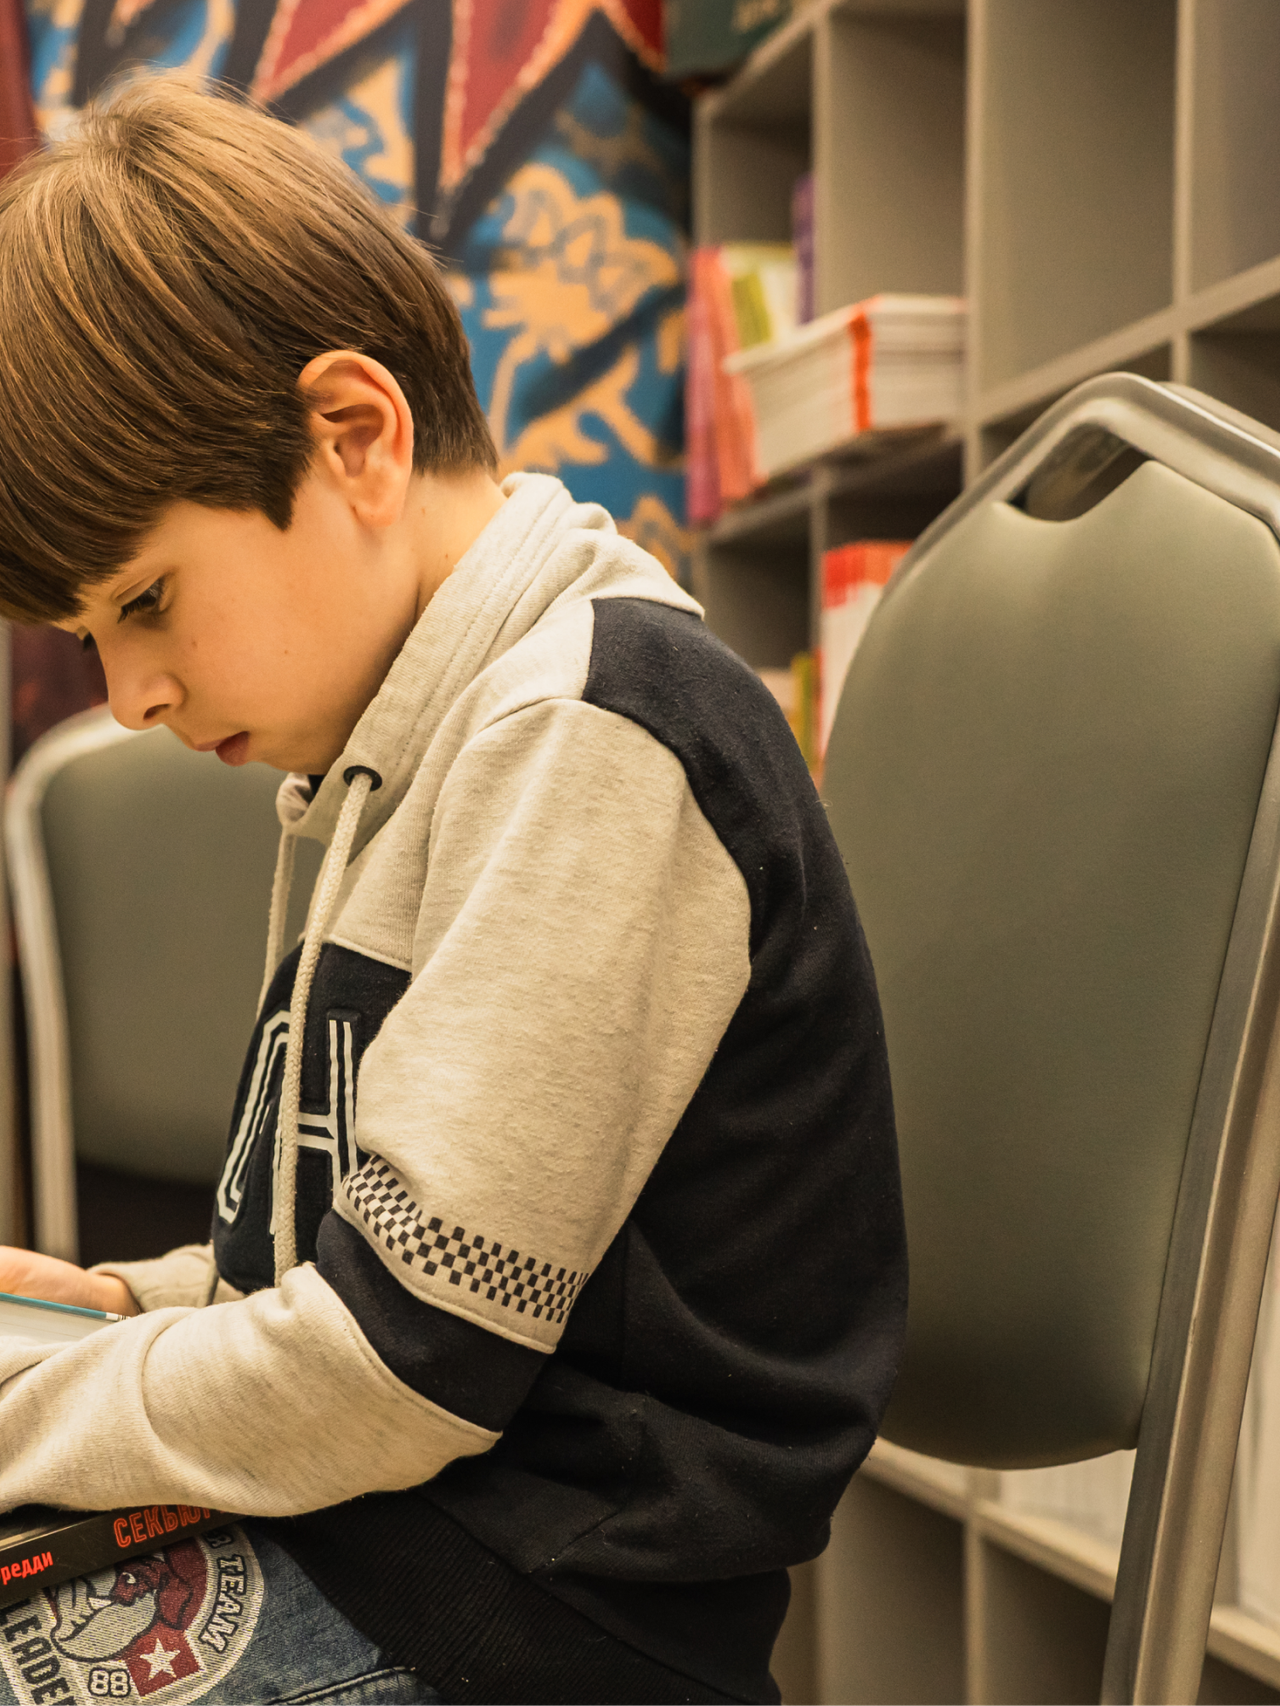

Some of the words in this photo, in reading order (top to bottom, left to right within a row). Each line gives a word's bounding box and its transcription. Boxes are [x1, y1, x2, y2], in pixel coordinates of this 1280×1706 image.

[113, 1504, 211, 1548] СЕКЬЮ
[197, 1554, 248, 1655] TEAM
[87, 1667, 131, 1697] 88
